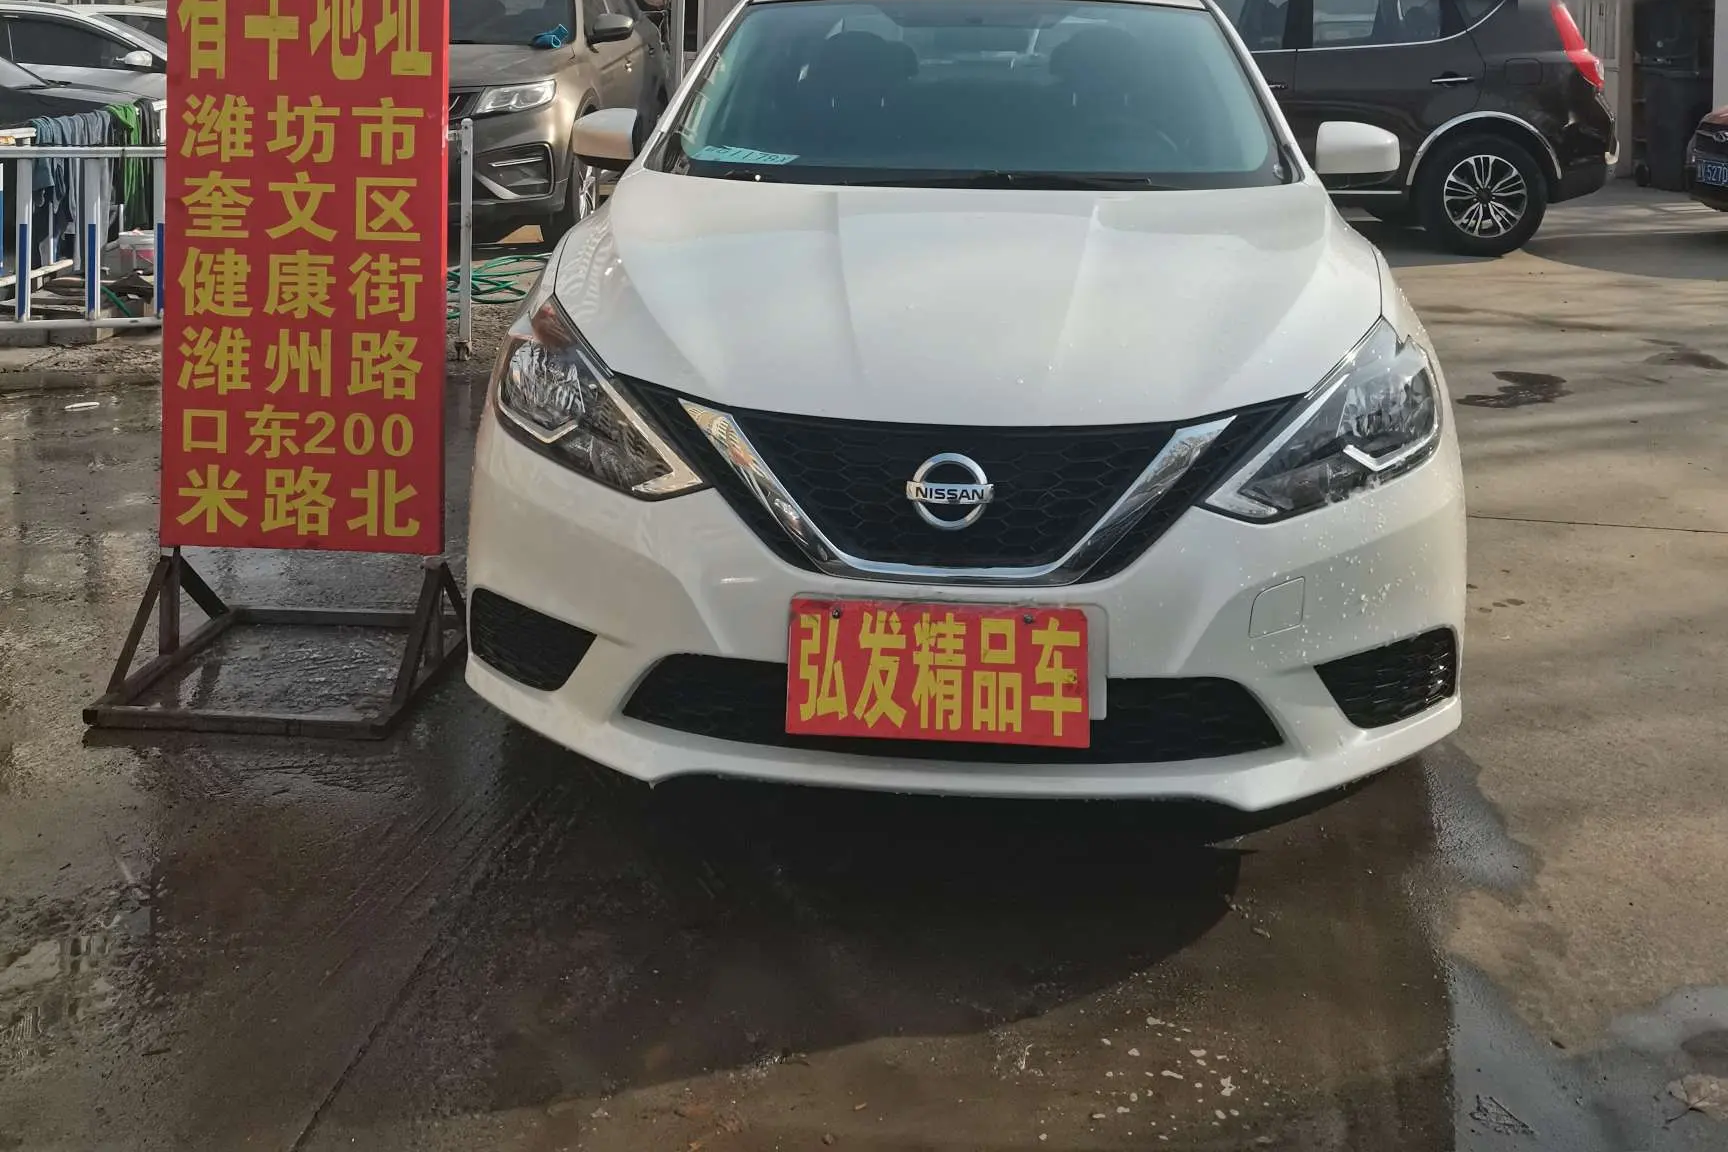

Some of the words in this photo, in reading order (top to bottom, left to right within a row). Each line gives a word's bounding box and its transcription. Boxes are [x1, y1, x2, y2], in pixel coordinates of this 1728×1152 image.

[180, 94, 425, 167] 潍坊市
[180, 171, 421, 243] 奎文区
[178, 246, 423, 322] 健康街
[177, 325, 423, 401] 潍州路
[182, 403, 415, 459] 口东200
[176, 464, 421, 537] 米路北
[915, 486, 985, 501] NISSAN
[799, 610, 1083, 737] 弘发精品车
